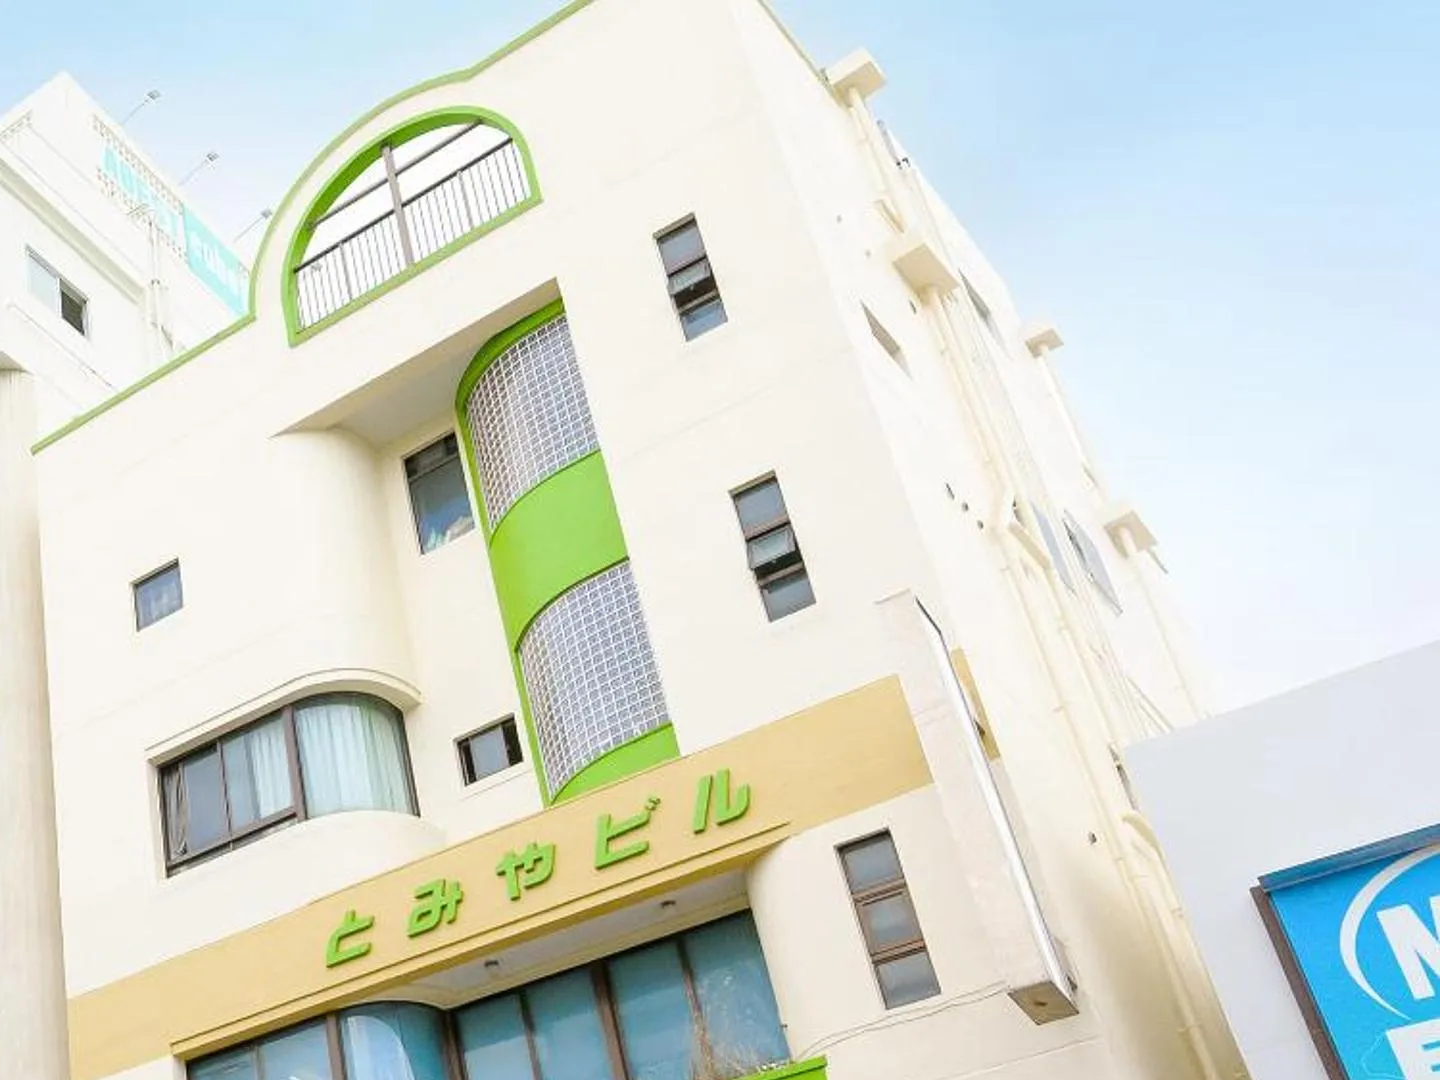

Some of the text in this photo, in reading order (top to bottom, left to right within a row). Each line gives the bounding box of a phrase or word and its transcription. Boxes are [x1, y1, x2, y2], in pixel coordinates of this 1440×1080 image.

[325, 768, 751, 968] とみやビル
